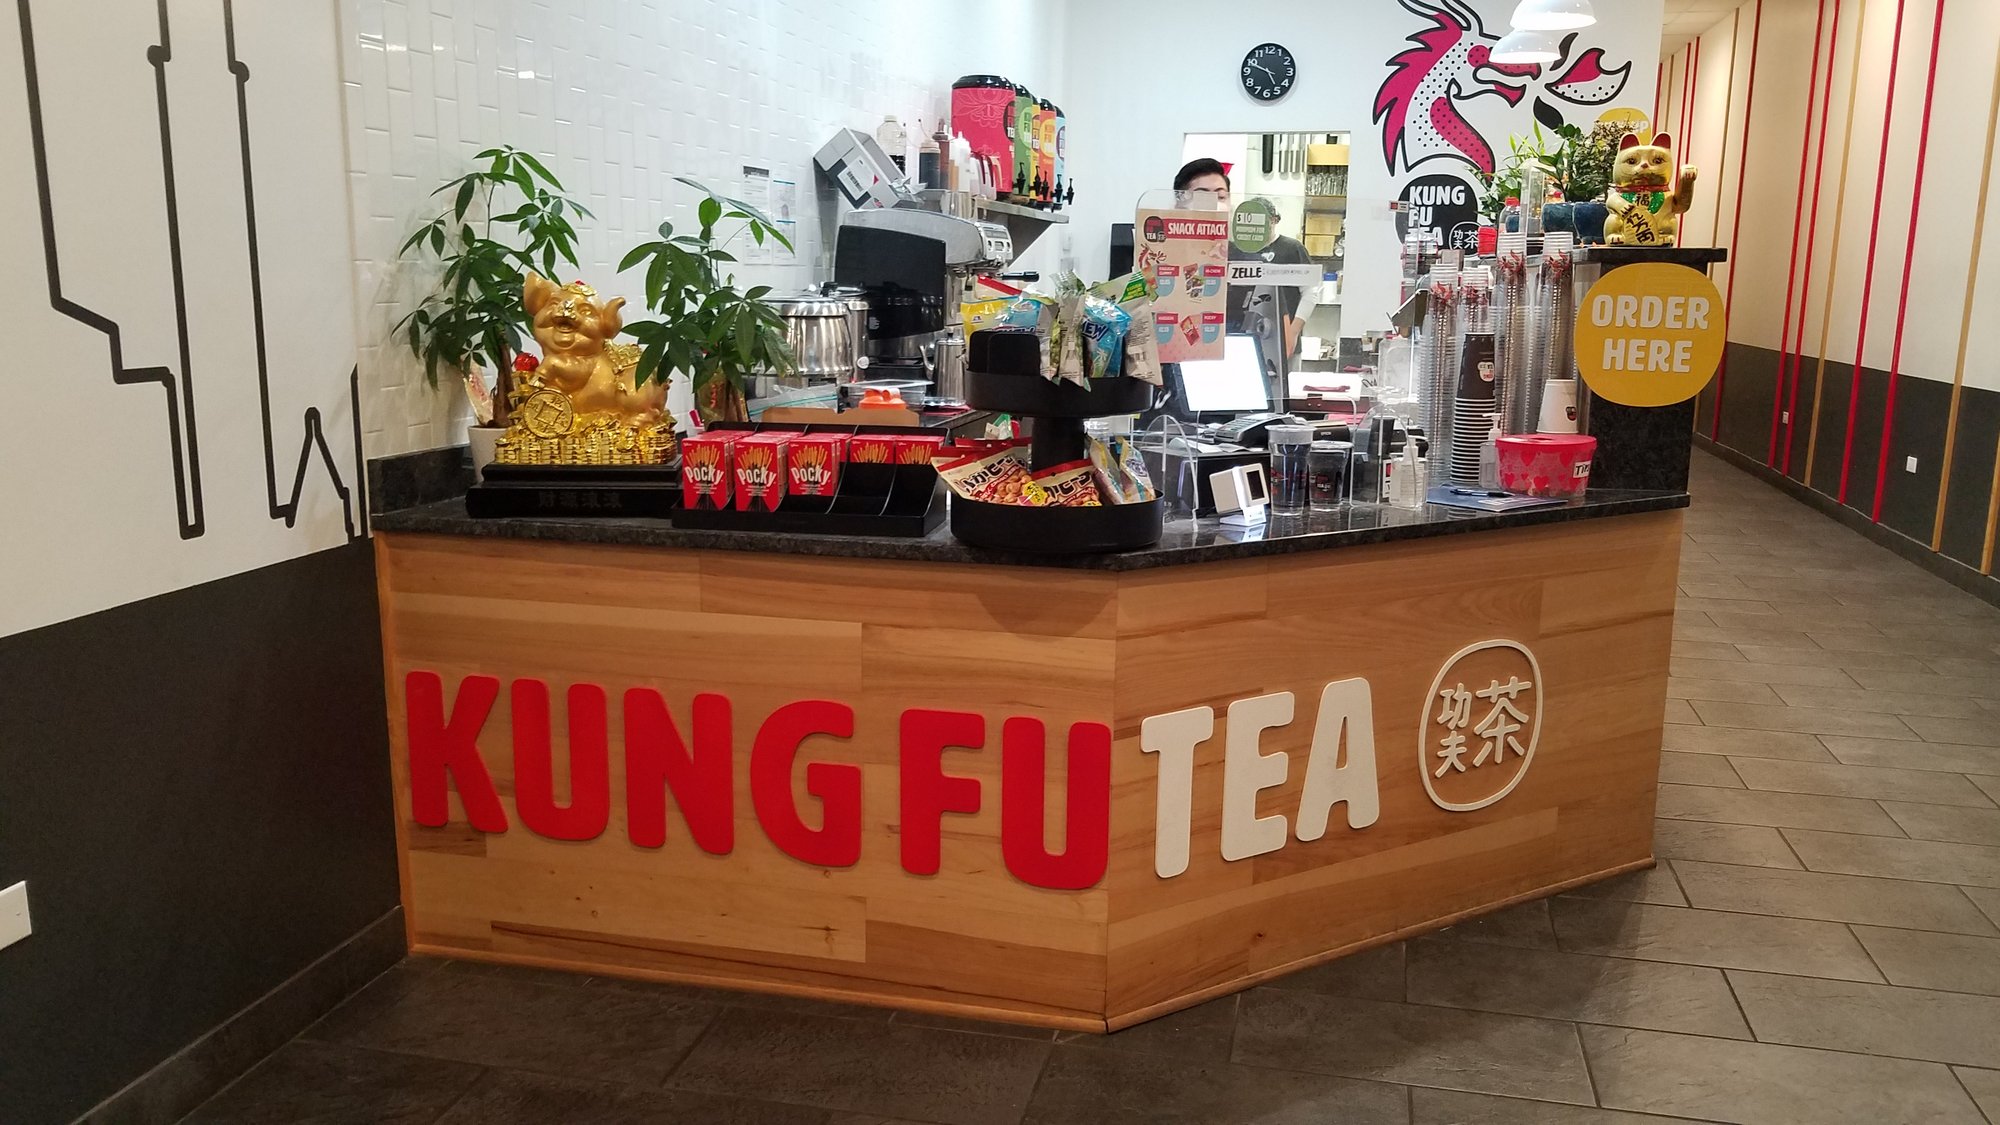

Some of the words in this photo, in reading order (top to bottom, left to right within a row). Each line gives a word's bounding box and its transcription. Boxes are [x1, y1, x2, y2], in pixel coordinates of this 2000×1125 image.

[1254, 50, 1264, 58] 11
[1264, 46, 1275, 54] 12
[1277, 48, 1282, 56] 1
[1246, 58, 1258, 66] 10
[1283, 56, 1291, 65] 2
[1243, 67, 1251, 76] 9
[1286, 68, 1294, 76] 3
[1246, 78, 1254, 86] 8
[1281, 78, 1289, 87] 4
[1254, 86, 1261, 94] 7
[1263, 89, 1271, 98] 6
[1273, 86, 1281, 94] 5
[1409, 186, 1466, 206] KUNG
[1634, 194, 1650, 206] 福
[1408, 206, 1433, 226] FU
[1168, 222, 1196, 235] SNACK
[1196, 223, 1226, 236] ATTACK
[1592, 294, 1710, 330] ORDER
[1602, 338, 1693, 373] HERE
[1434, 676, 1532, 778] 功夫茶
[406, 670, 861, 867] KUNG
[900, 708, 1111, 890] FU
[1140, 677, 1380, 878] TEA
